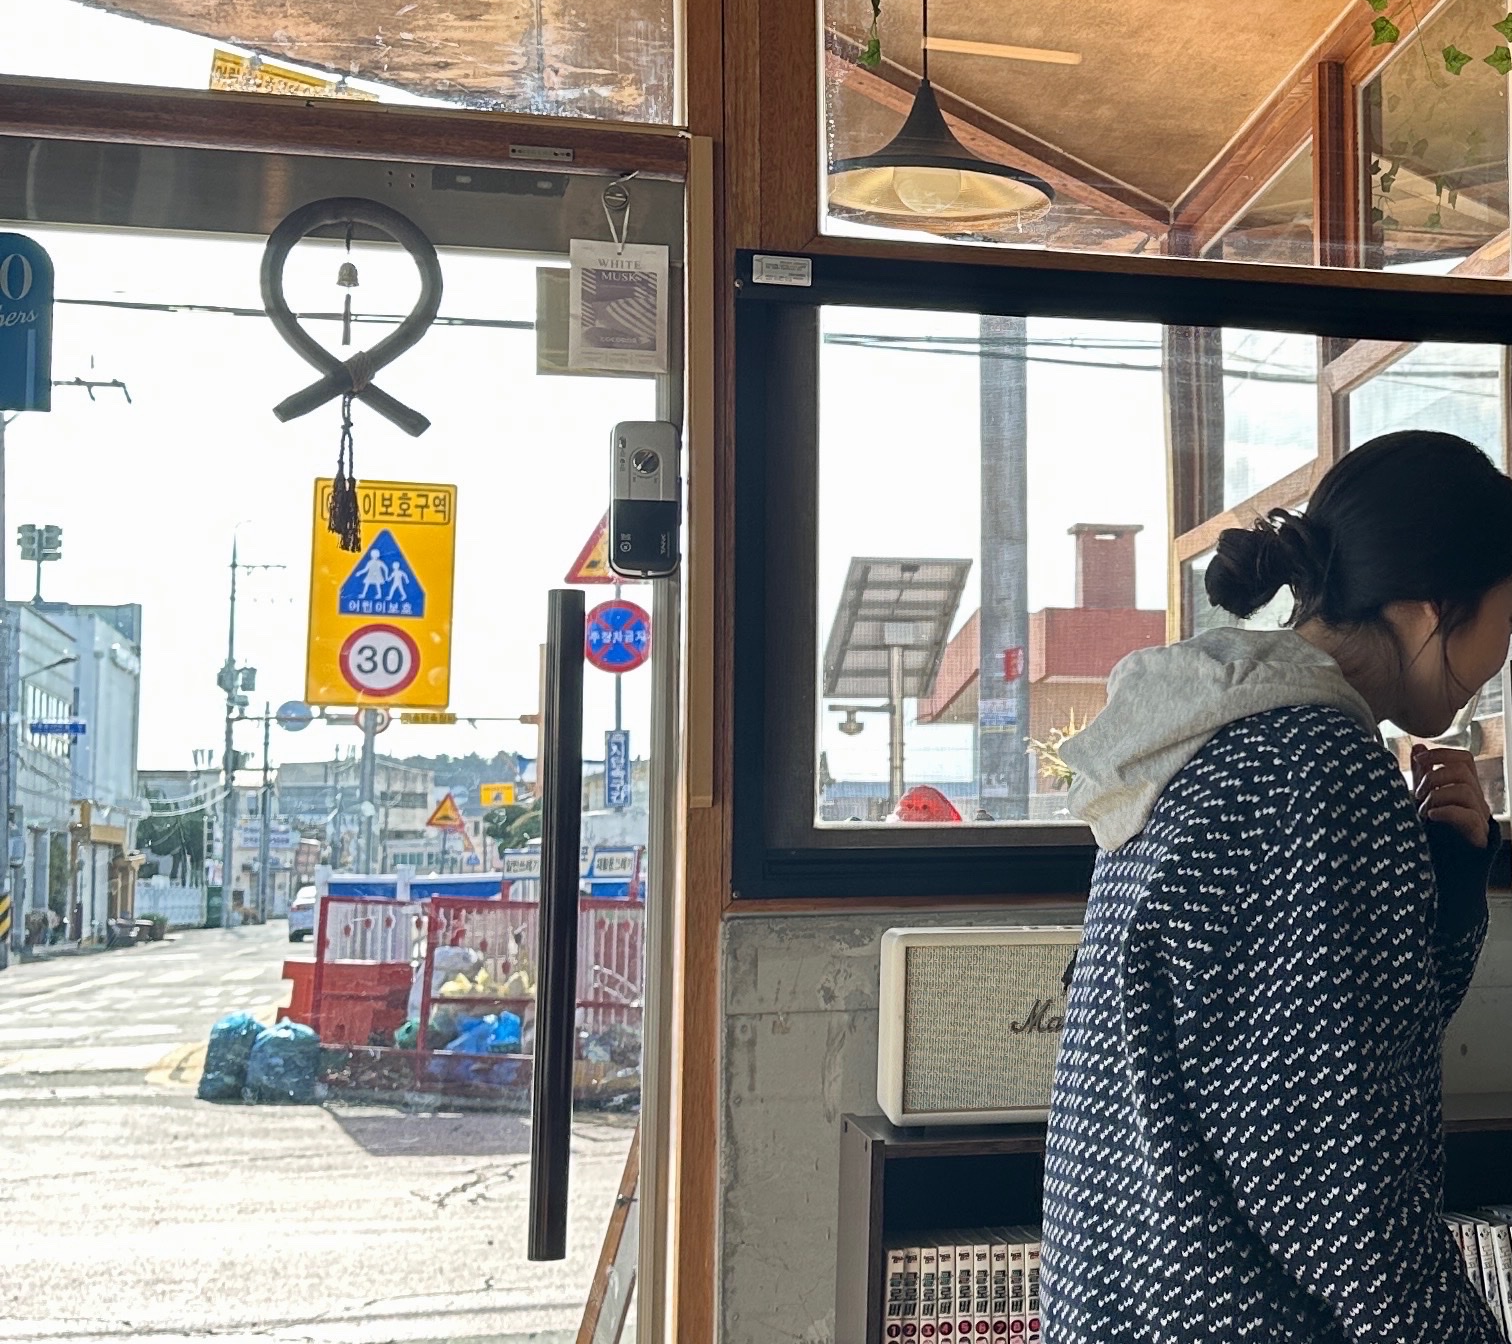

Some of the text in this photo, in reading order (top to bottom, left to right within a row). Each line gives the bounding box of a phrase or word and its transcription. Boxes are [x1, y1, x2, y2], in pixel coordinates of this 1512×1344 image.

[598, 258, 642, 270] WHITE
[601, 271, 642, 281] MUSK
[327, 490, 448, 522] 이보호구역
[348, 600, 414, 615] 어린이보호
[356, 645, 405, 675] 30
[888, 1272, 903, 1316] 클로버
[903, 1272, 918, 1316] 클로버
[921, 1272, 935, 1316] 클로버
[939, 1271, 953, 1314] 클로버
[958, 1269, 971, 1313] 클로버
[976, 1270, 988, 1313] 클로버
[993, 1270, 1006, 1313] 클로버
[1010, 1269, 1023, 1312] 클로버
